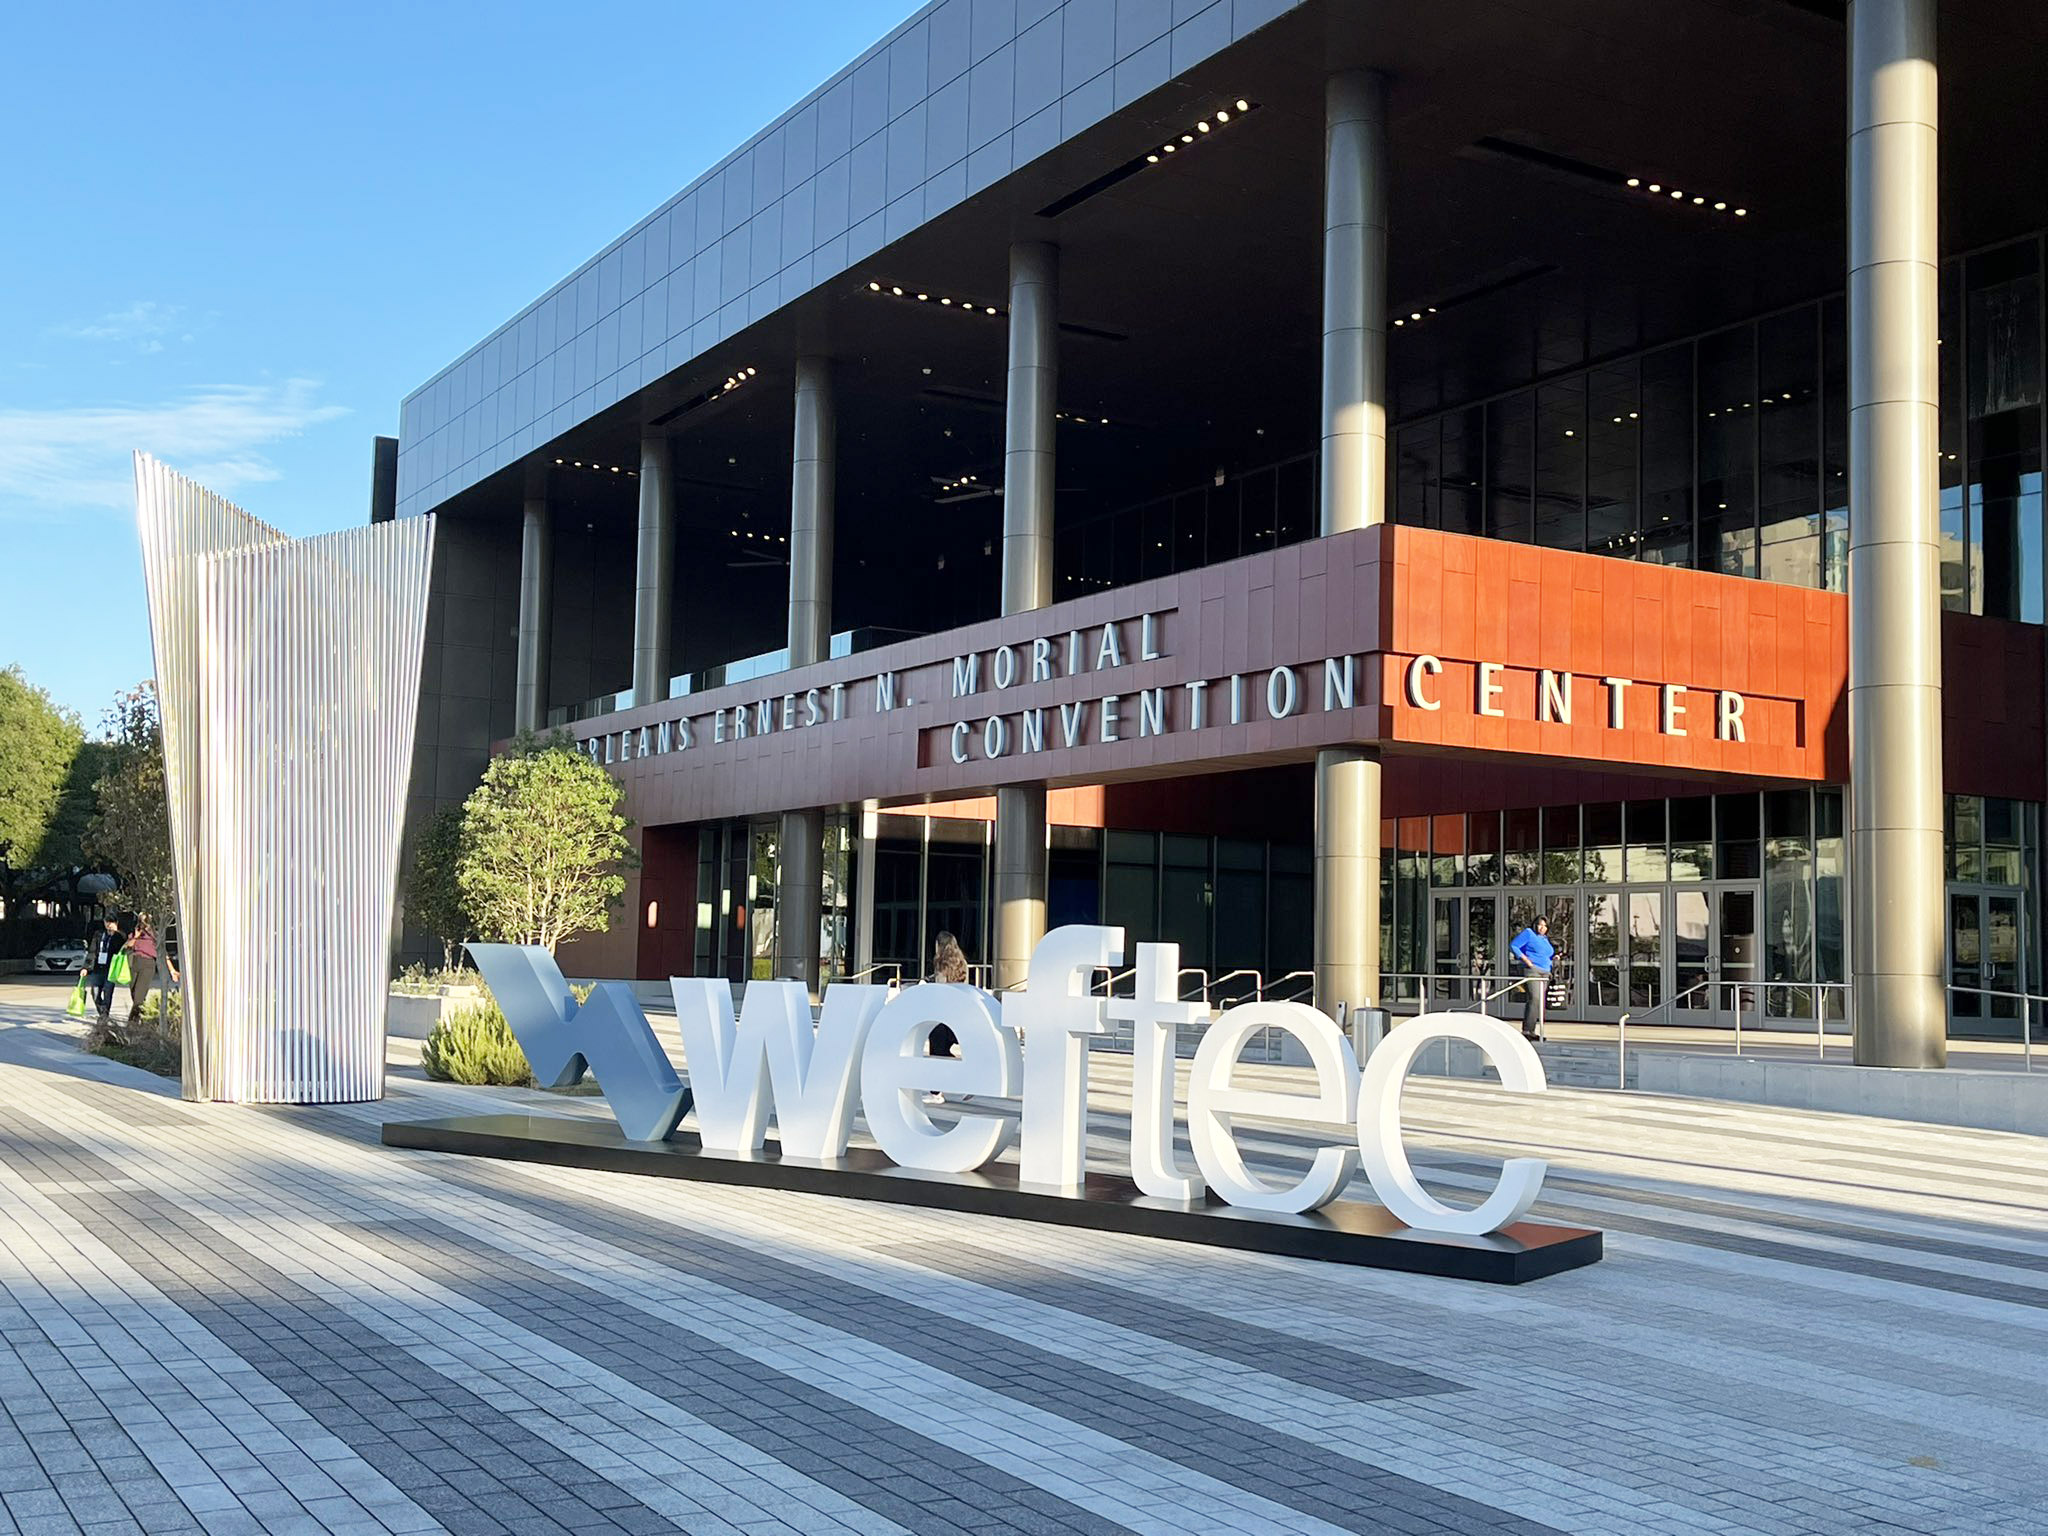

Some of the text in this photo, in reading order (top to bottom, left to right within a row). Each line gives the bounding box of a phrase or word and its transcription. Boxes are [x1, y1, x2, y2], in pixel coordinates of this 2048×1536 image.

[576, 613, 1160, 765] RLEANS ERNEST N. MORIAL
[951, 653, 1747, 764] CONVENTION CENTER
[670, 924, 1548, 1236] weftec
